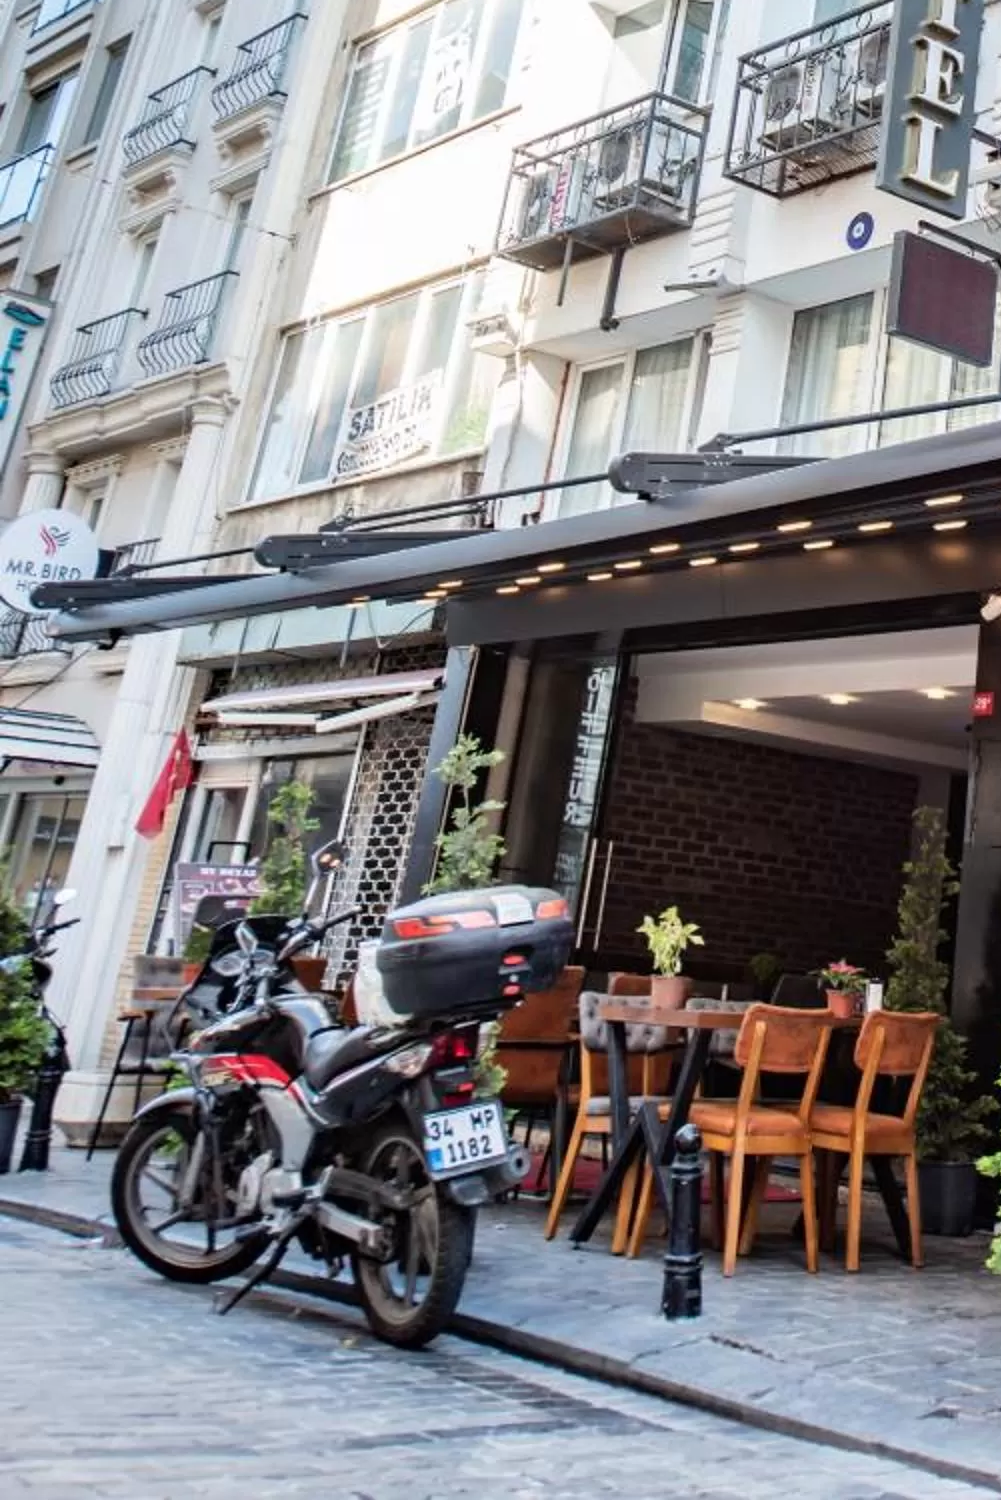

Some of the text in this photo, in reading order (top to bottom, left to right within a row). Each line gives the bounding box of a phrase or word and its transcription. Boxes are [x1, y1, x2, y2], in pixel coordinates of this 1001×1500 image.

[5, 559, 82, 581] MR. BIRD
[430, 1118, 454, 1141] 34
[447, 1134, 493, 1163] 1182
